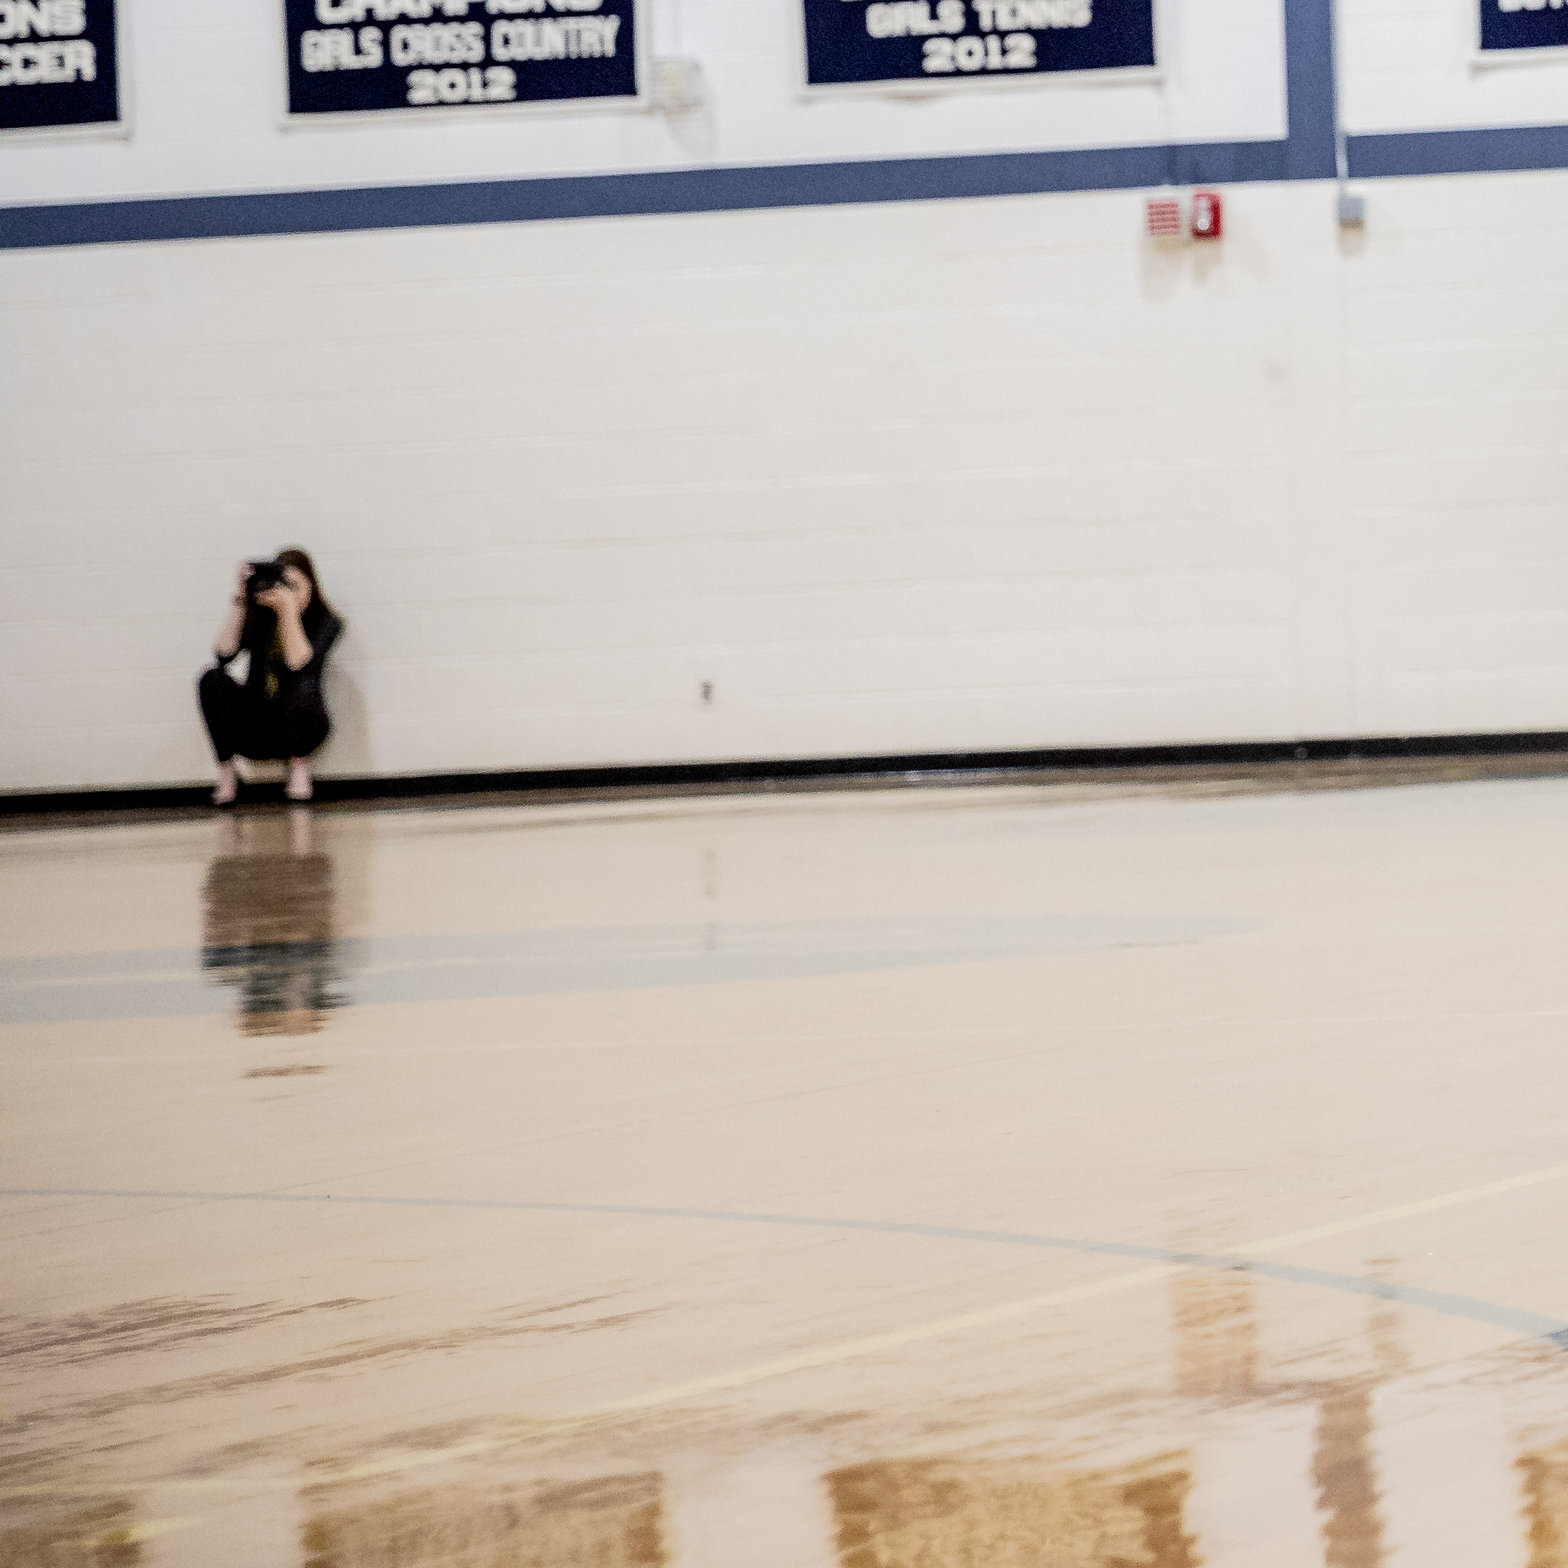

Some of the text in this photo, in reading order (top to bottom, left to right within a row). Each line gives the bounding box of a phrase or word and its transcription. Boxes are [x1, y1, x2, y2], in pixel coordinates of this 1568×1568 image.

[866, 0, 964, 38] GIRLS
[300, 14, 621, 72] GIRLS CROSS COUNTRY
[920, 33, 1038, 74] 2012
[406, 66, 517, 105] 2012
